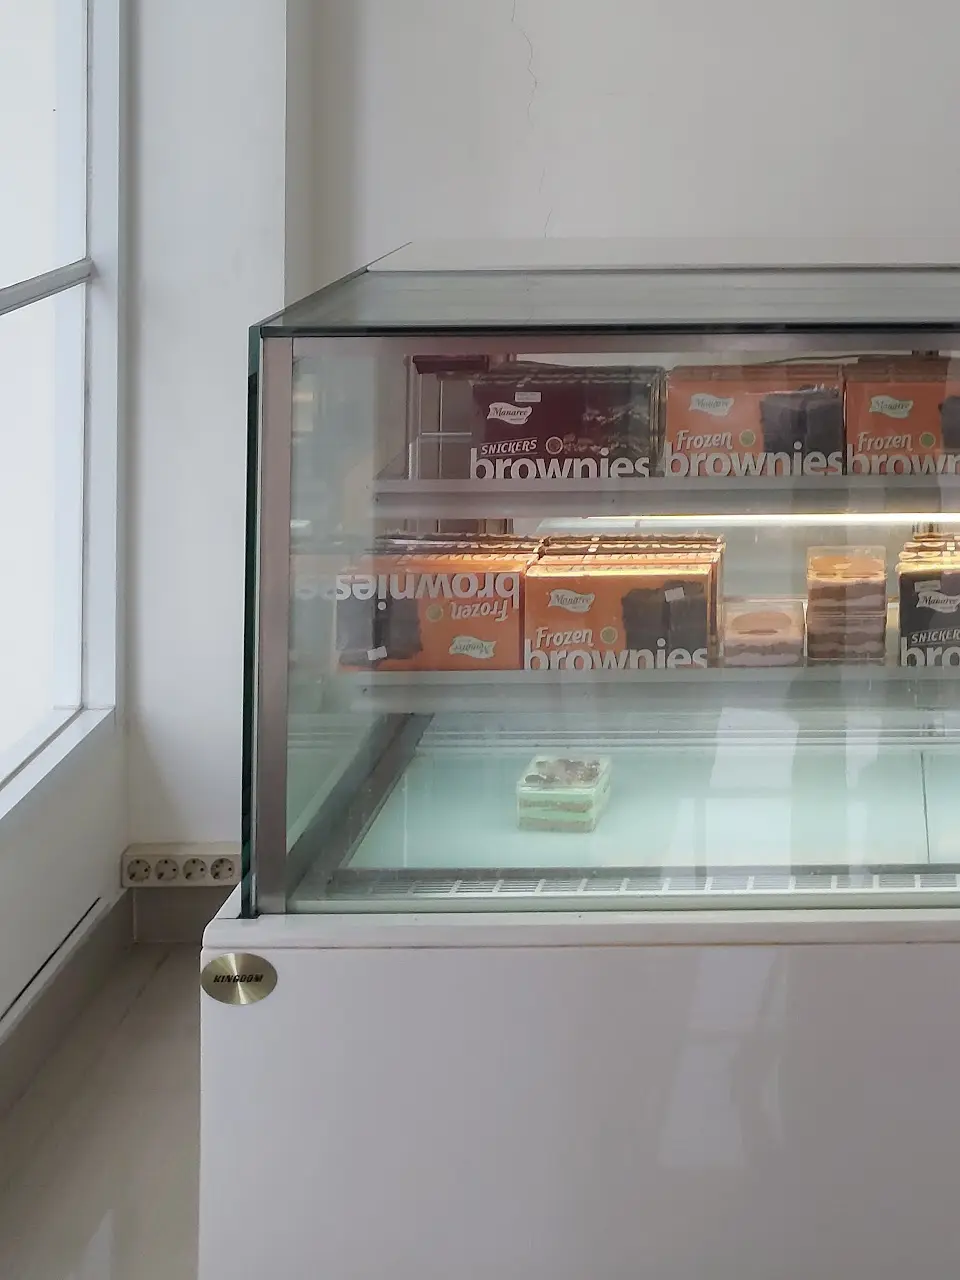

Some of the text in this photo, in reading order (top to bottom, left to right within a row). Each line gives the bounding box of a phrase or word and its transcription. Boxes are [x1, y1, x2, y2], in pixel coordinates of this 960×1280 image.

[480, 439, 538, 455] SNICKERS
[676, 429, 733, 451] Frozen
[857, 431, 914, 452] Frozen
[470, 447, 650, 479] brownies
[664, 440, 843, 477] brownies
[335, 573, 519, 610] brownies
[450, 600, 508, 622] Frozen
[535, 626, 595, 648] Frozen
[524, 637, 708, 669] brownies
[213, 974, 264, 983] KINGDOM
